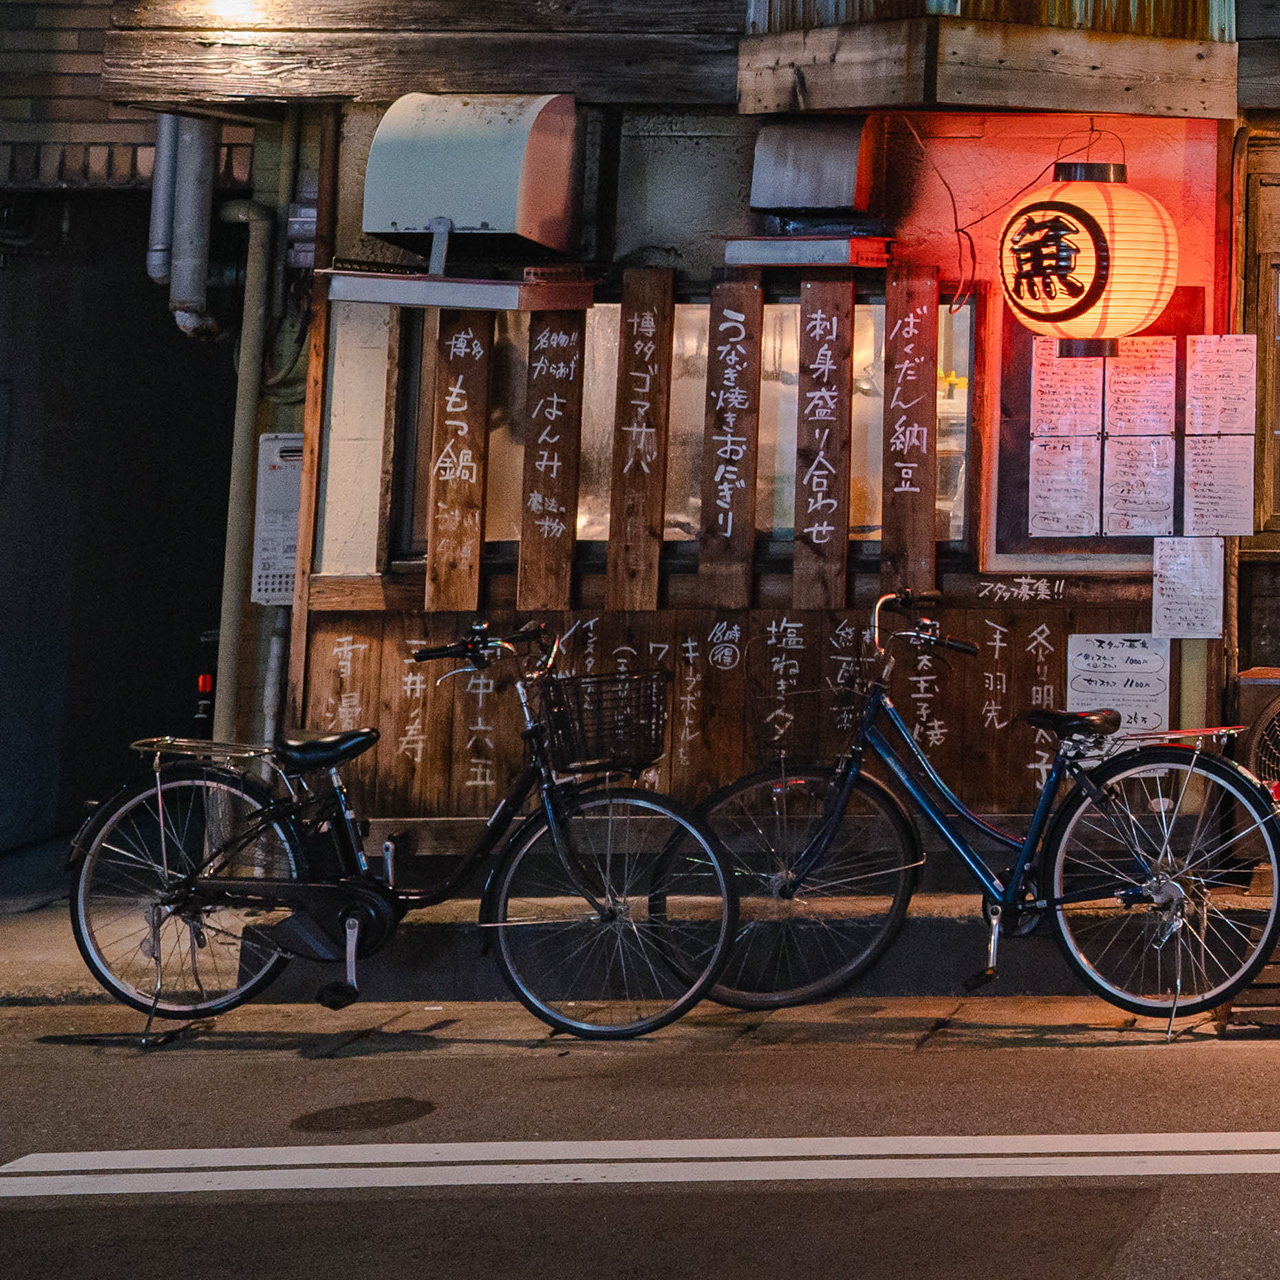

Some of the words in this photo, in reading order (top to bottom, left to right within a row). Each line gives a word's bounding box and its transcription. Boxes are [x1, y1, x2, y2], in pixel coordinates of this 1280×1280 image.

[445, 328, 484, 360] 博多
[889, 305, 928, 493] ばくだん納豆
[433, 375, 477, 483] もつ鍋
[531, 392, 567, 478] はんみ
[710, 308, 749, 538] うなぎ焼きおにぎり
[803, 308, 838, 544] 刺身盛り合わせ
[982, 619, 1009, 730] 手羽先
